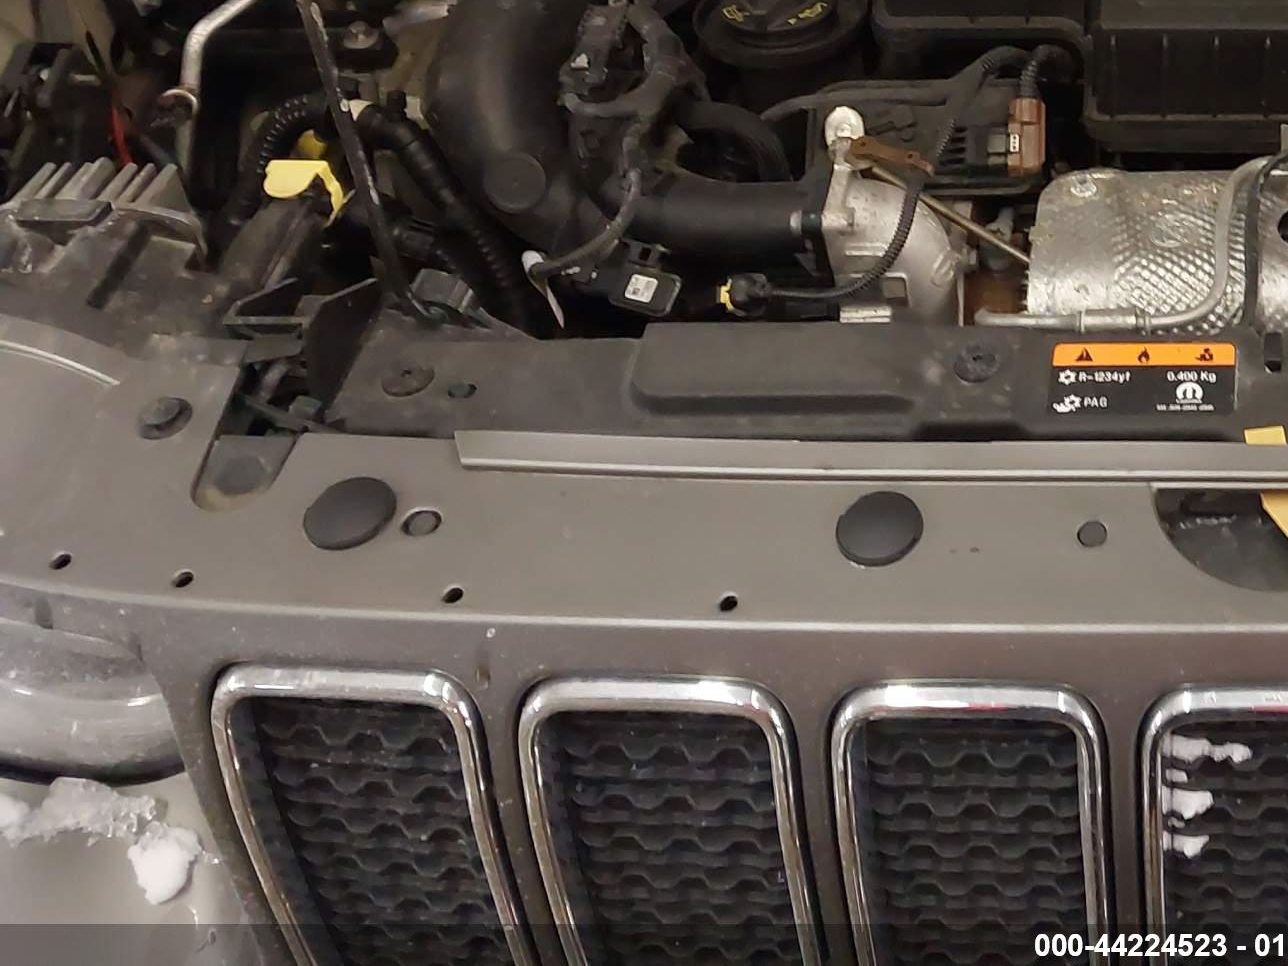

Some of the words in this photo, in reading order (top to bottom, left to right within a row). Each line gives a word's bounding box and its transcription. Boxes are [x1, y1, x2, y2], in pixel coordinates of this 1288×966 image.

[1166, 370, 1198, 382] 0.400
[1200, 370, 1217, 384] Kg
[1084, 396, 1108, 408] PAG
